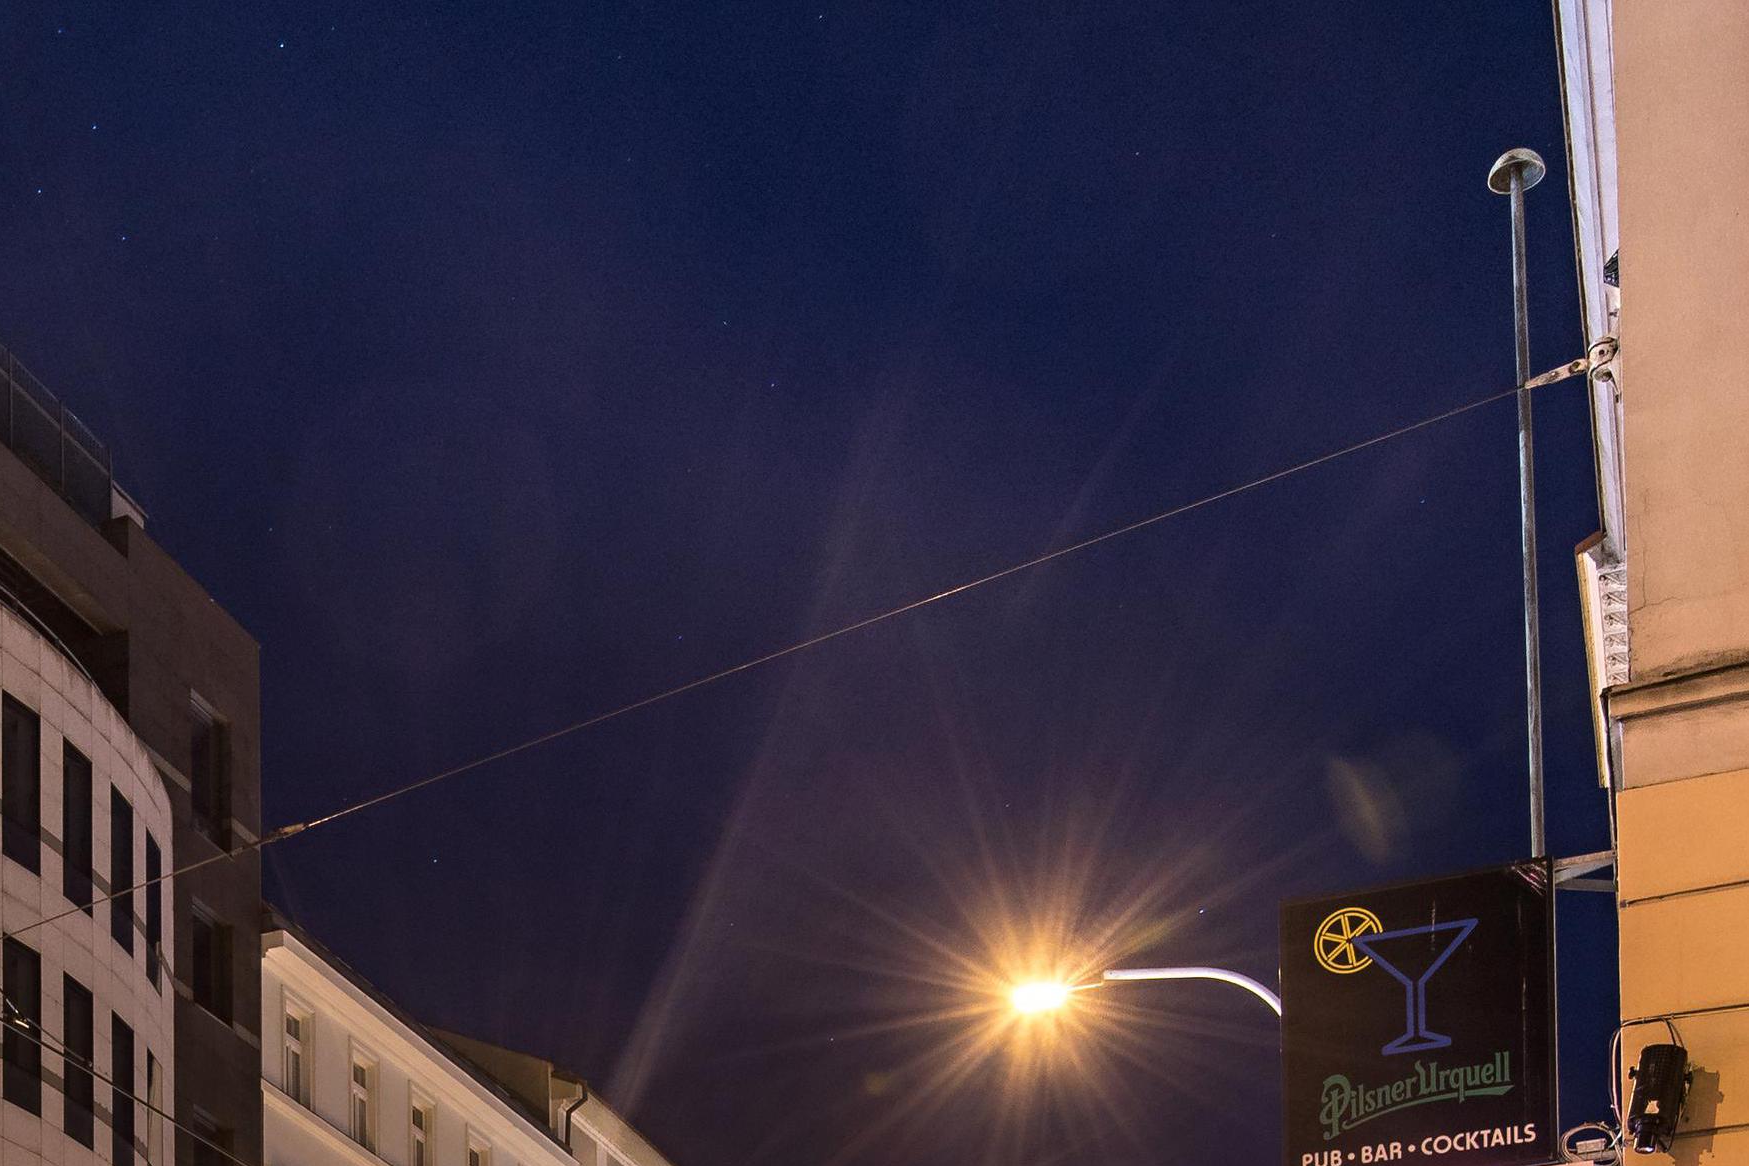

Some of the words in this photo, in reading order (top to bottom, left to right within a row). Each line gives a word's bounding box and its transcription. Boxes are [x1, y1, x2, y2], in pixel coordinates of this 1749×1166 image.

[1320, 1074, 1415, 1140] Pilsner
[1414, 1051, 1512, 1104] Urquell
[1362, 1141, 1402, 1163] BAR
[1421, 1123, 1537, 1156] COCKTAILS
